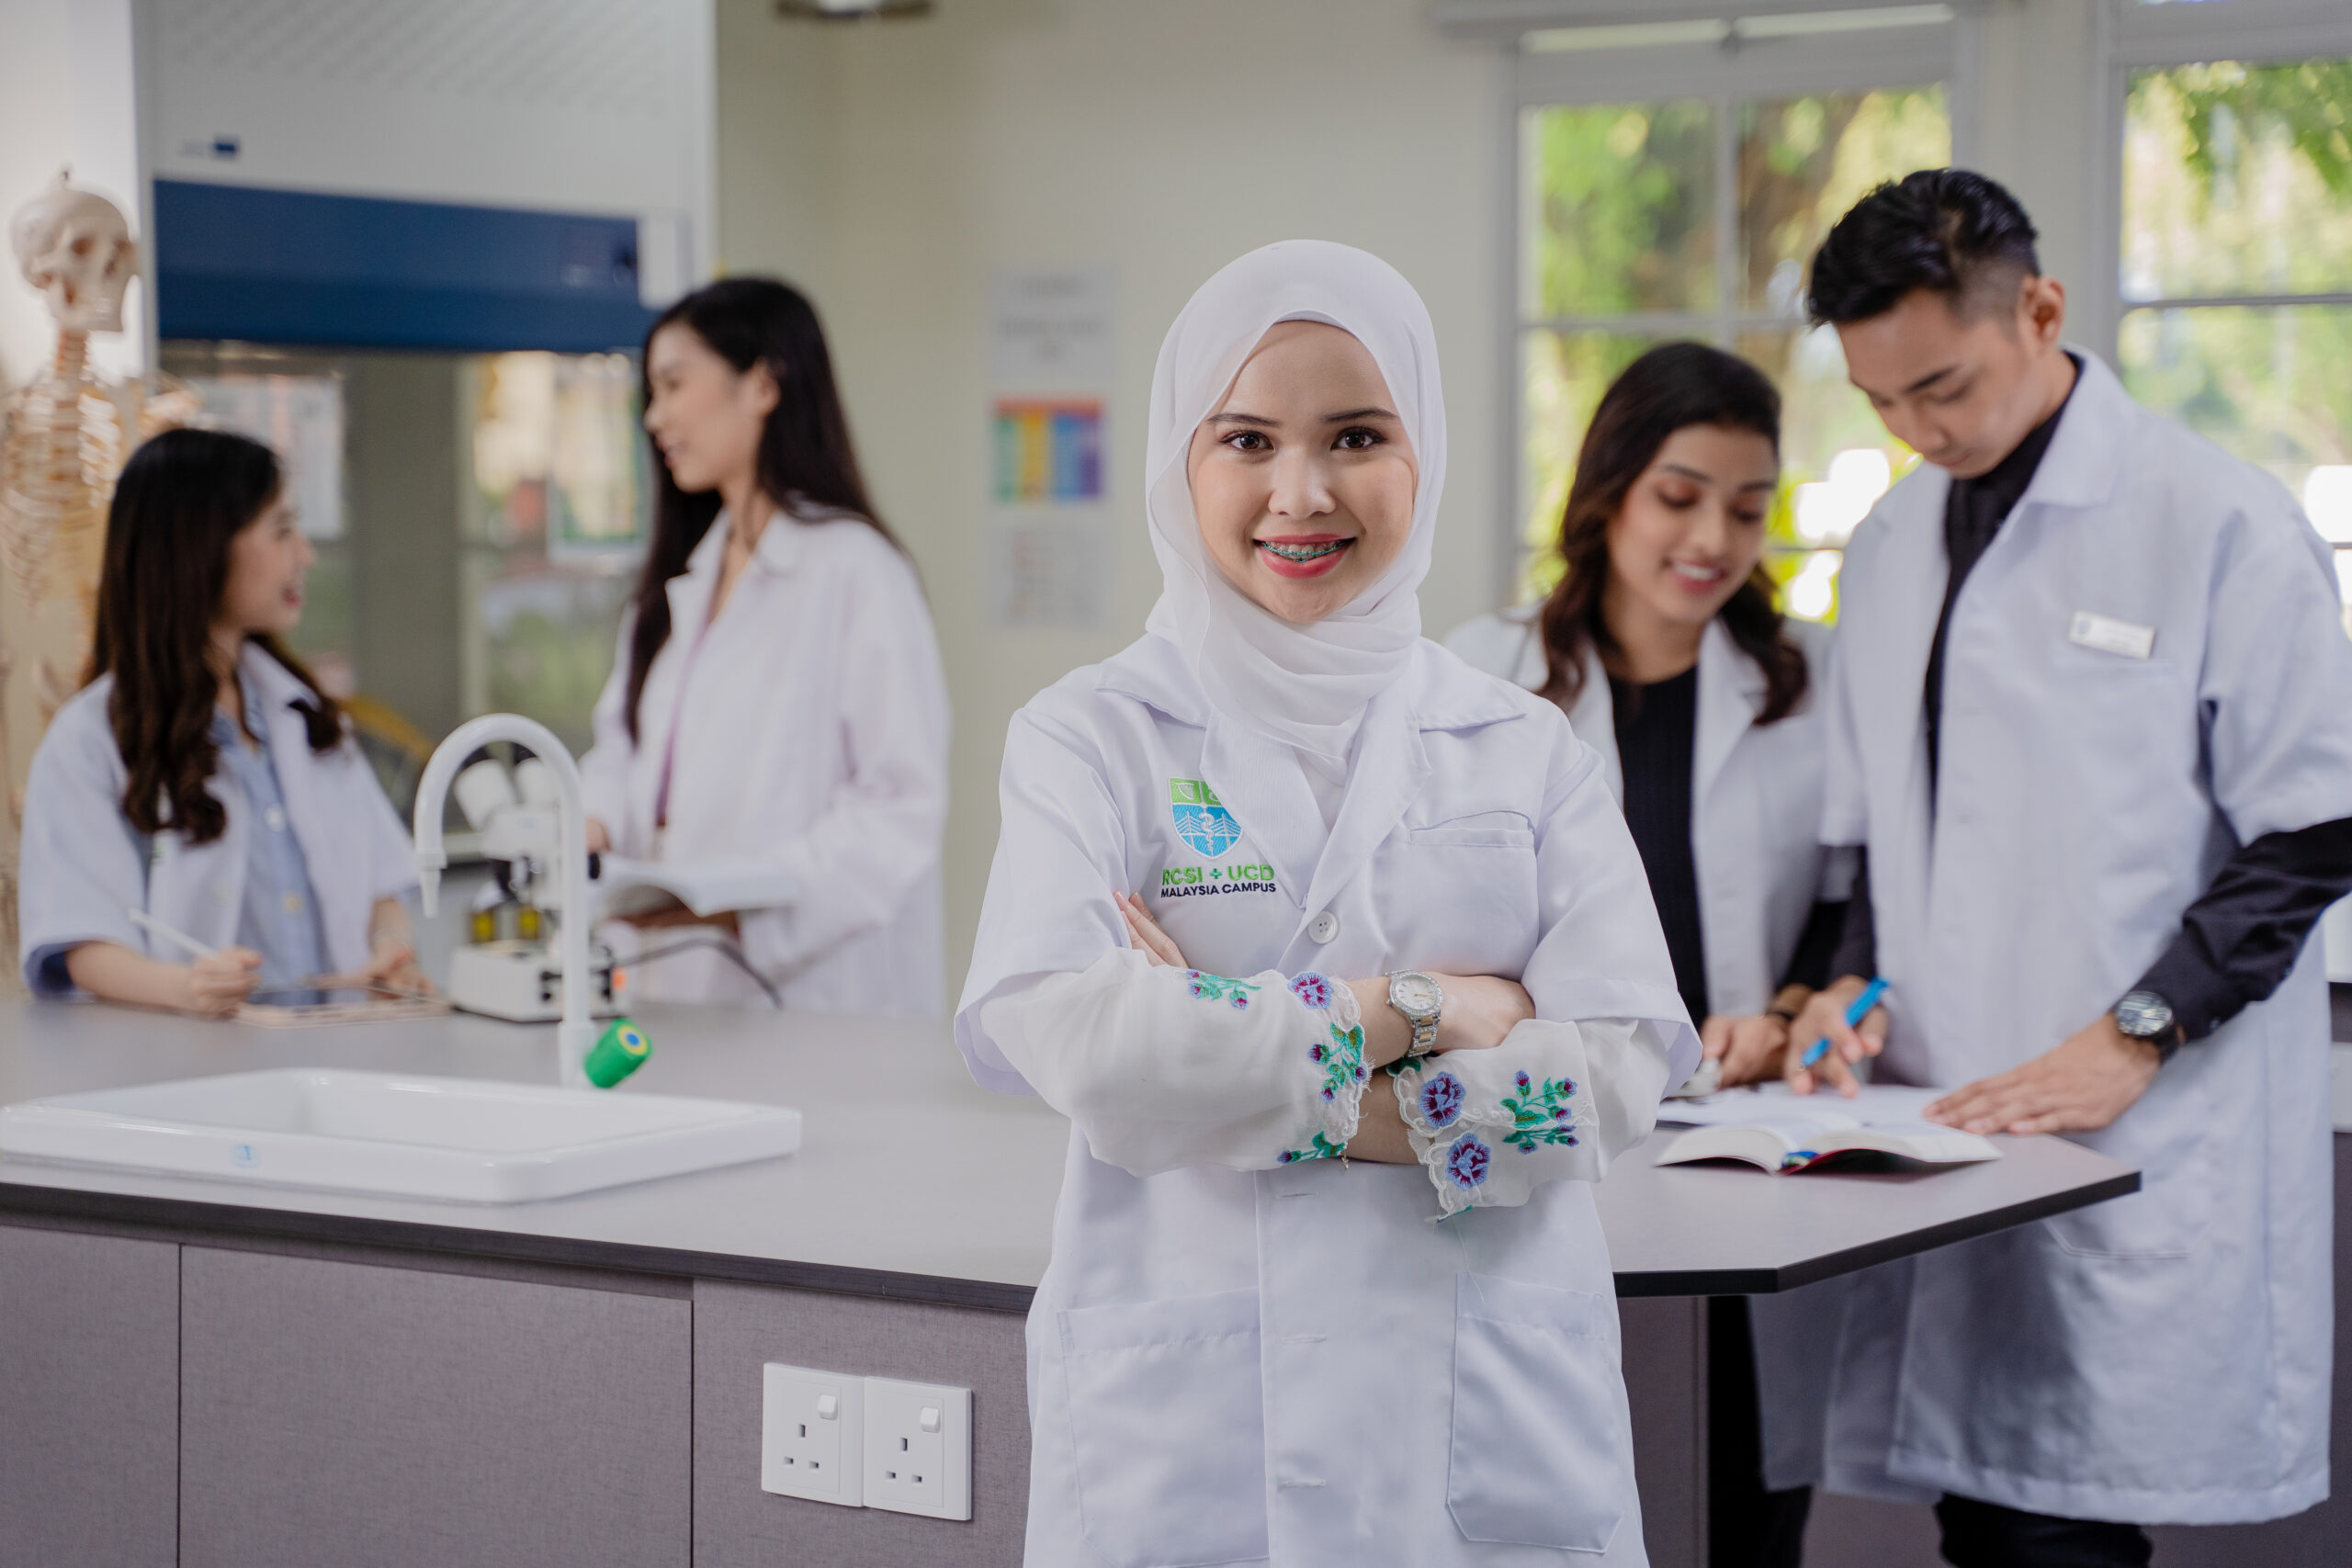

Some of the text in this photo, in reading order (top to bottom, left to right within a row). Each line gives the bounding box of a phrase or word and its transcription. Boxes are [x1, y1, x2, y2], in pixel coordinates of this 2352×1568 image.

[1162, 867, 1203, 886] RCSI
[1227, 864, 1274, 881] UCD
[1160, 883, 1276, 898] MALAYSIA CAMPUS
